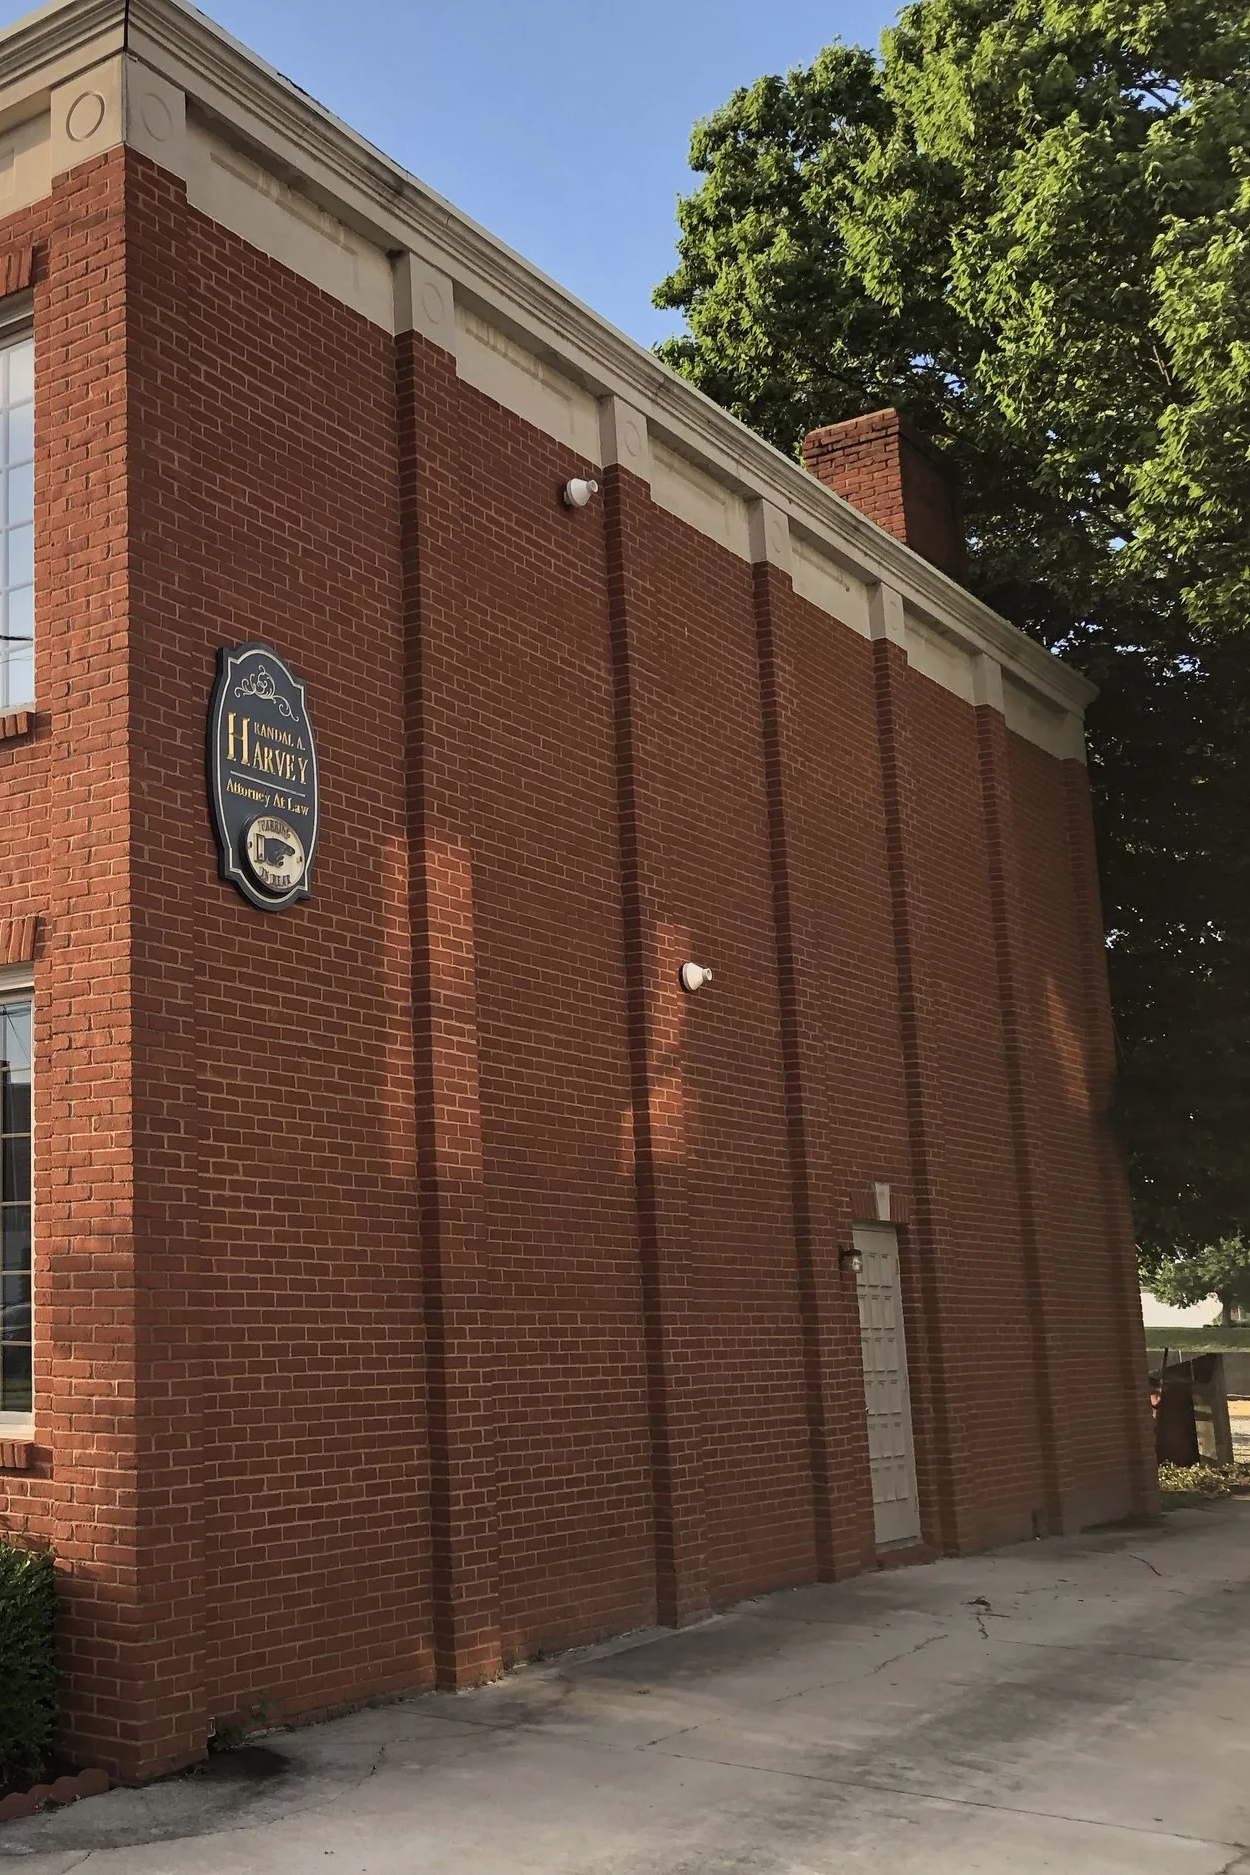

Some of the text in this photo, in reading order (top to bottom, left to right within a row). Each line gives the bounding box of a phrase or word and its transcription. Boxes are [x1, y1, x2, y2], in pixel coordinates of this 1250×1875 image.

[226, 712, 309, 785] HARVEY
[253, 721, 306, 751] RANDAL A.
[225, 777, 310, 816] Attorney At Law
